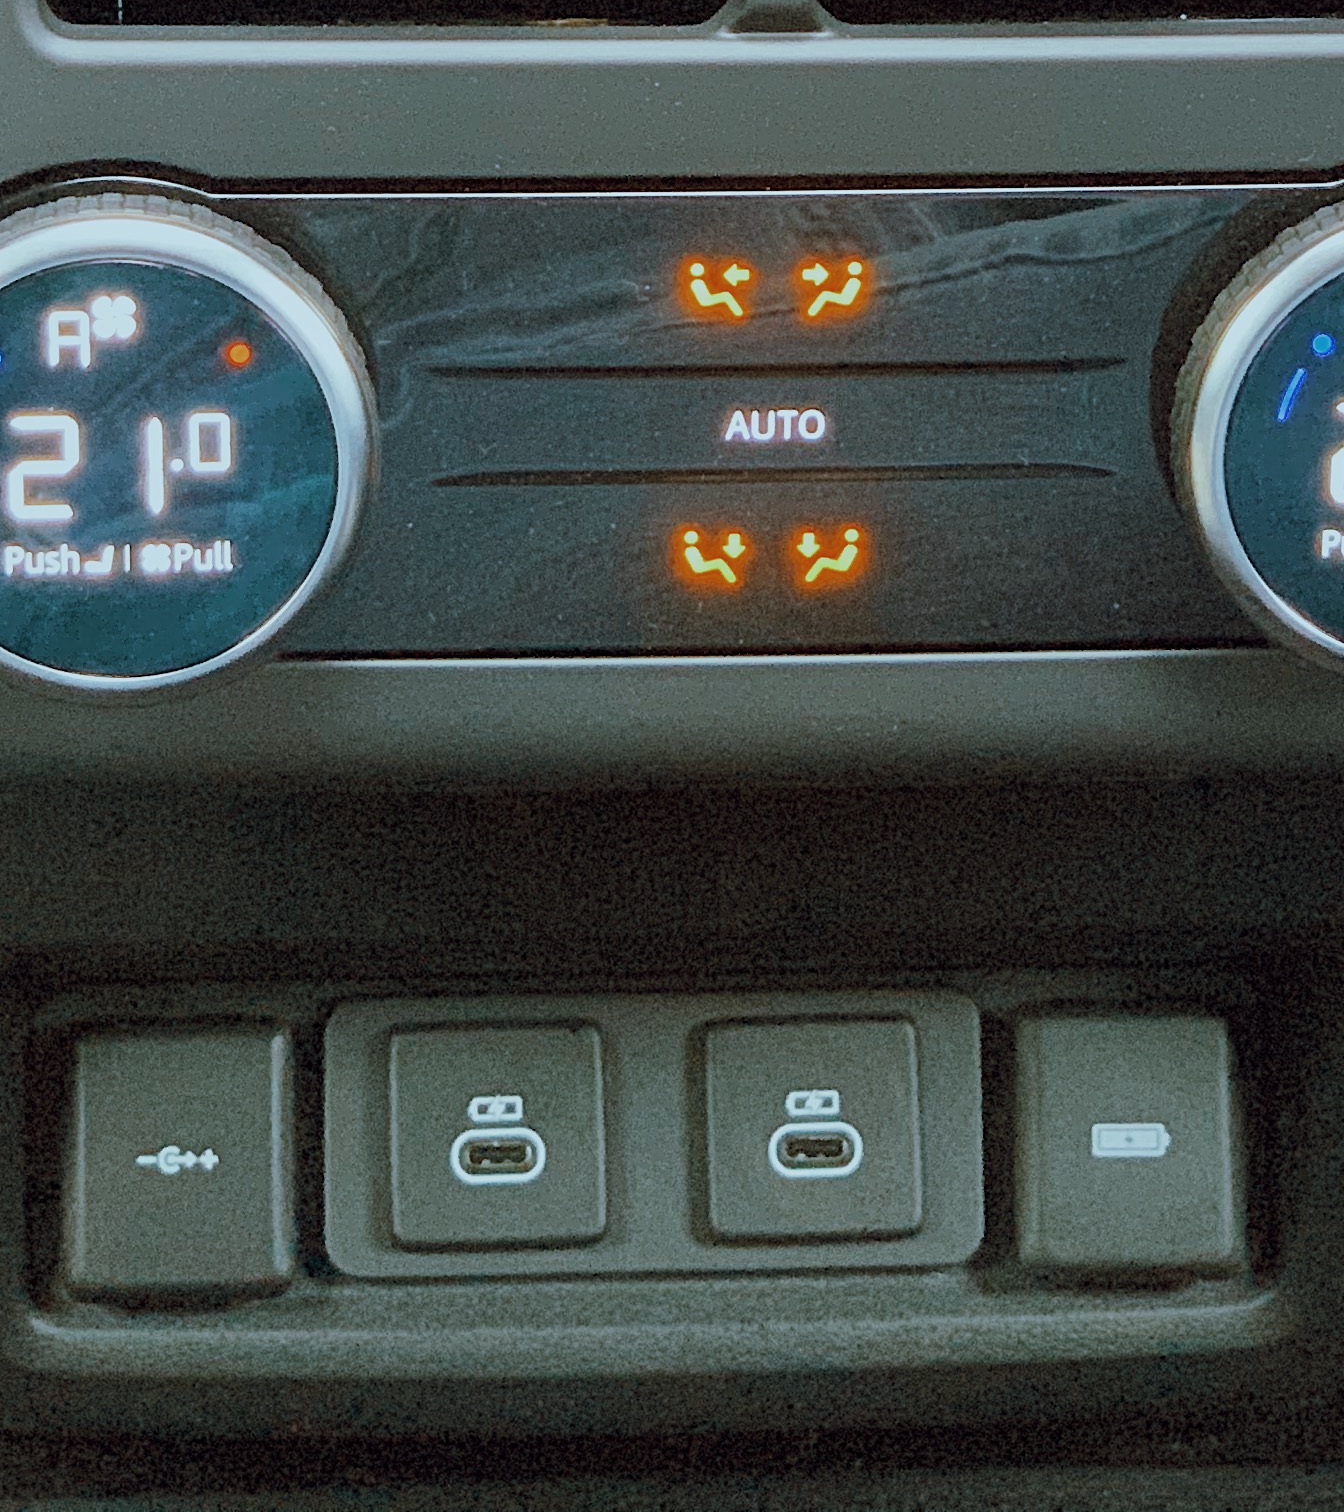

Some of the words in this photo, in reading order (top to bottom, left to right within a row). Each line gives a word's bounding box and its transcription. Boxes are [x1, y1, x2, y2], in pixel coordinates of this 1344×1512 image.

[724, 408, 827, 441] AUTO
[7, 412, 232, 520] 21.0
[4, 543, 81, 576] Push
[174, 540, 234, 571] Pull
